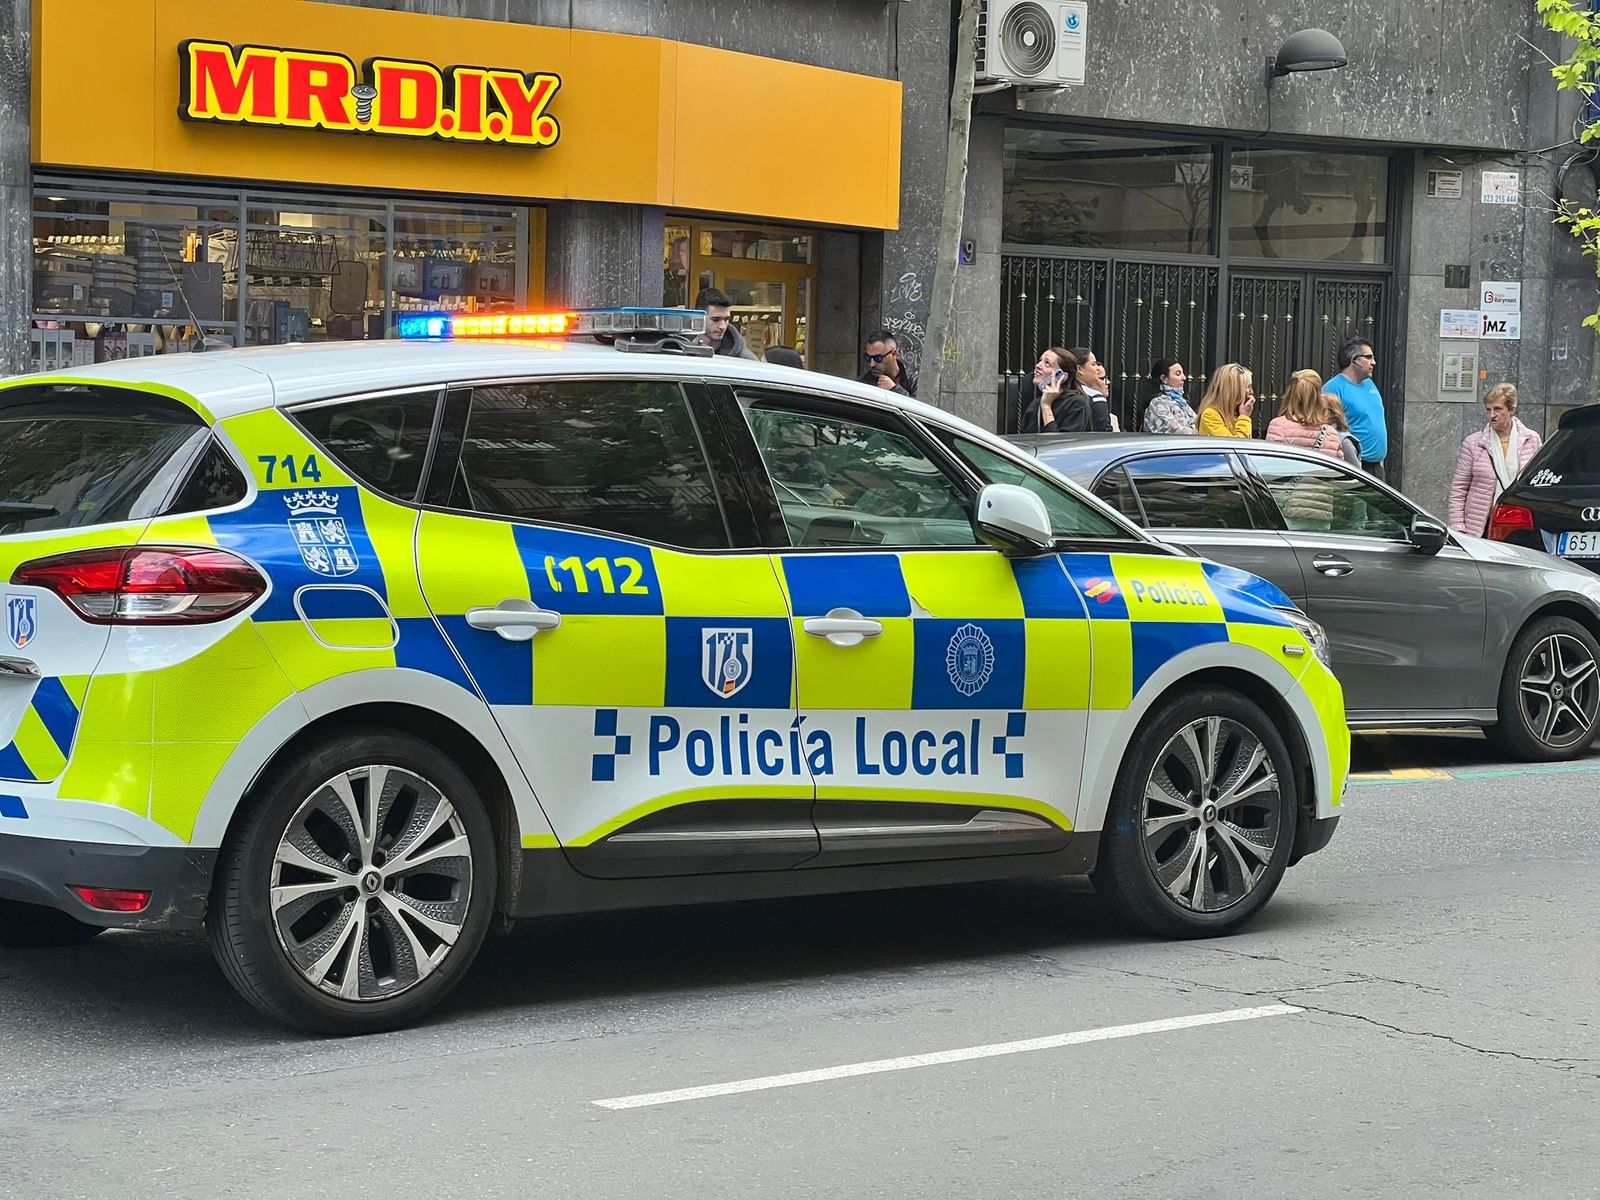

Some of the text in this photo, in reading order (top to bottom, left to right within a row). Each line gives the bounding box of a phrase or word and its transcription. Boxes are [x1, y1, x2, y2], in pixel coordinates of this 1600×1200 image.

[190, 44, 557, 140] MR D.I.Y.
[963, 241, 973, 262] 9
[258, 454, 322, 483] 714
[1569, 535, 1597, 551] 651
[558, 556, 649, 595] 112
[648, 713, 981, 777] Policía Local
